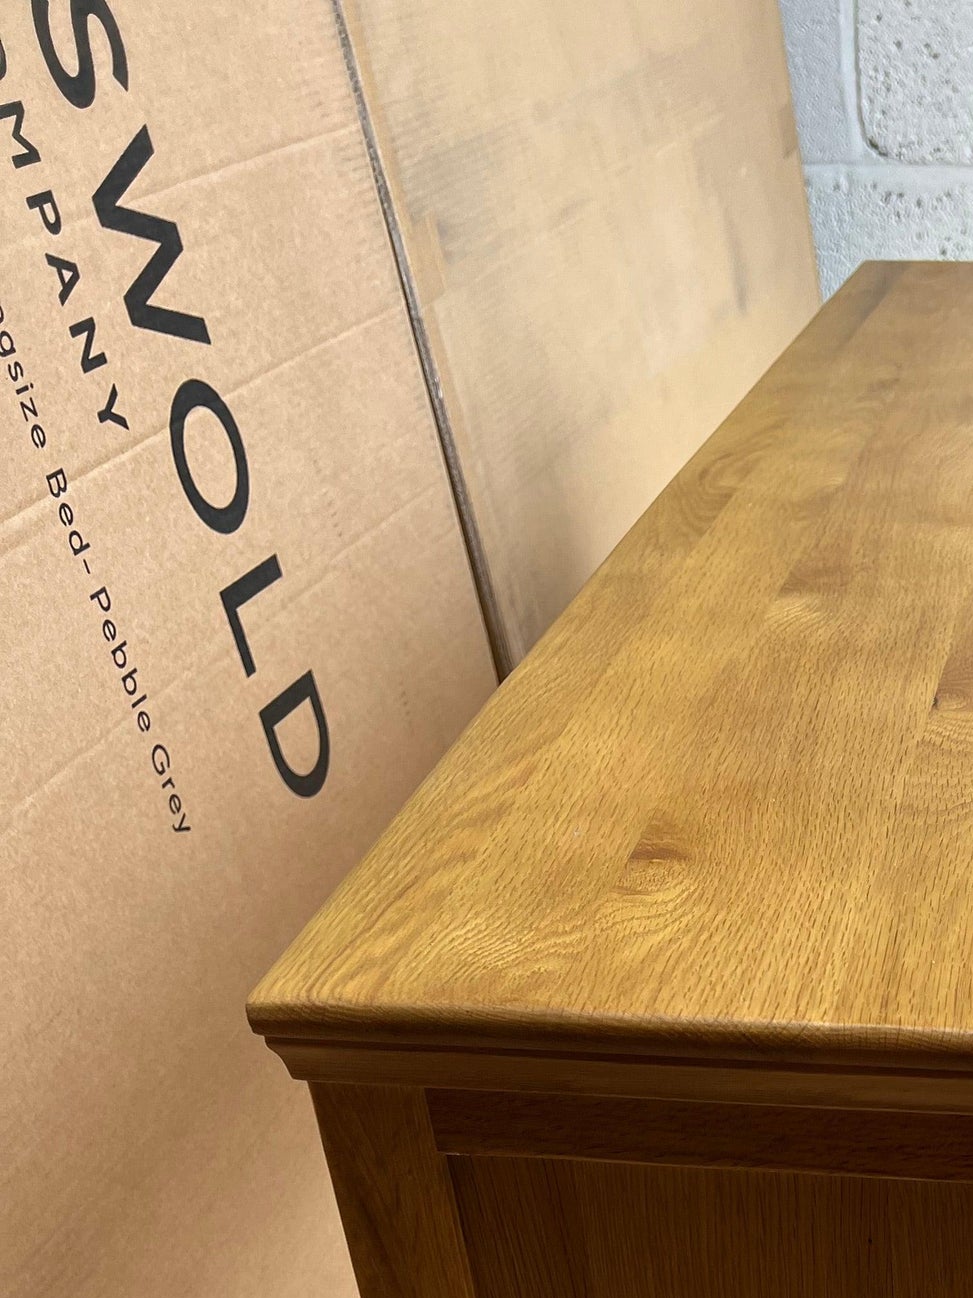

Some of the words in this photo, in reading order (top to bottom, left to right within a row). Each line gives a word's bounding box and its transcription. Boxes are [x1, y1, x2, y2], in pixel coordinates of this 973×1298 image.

[0, 39, 130, 431] MPANY
[30, 0, 331, 798] SWOLD
[45, 467, 91, 575] Bed-
[89, 585, 151, 733] Pebble
[151, 743, 192, 833] Grey
